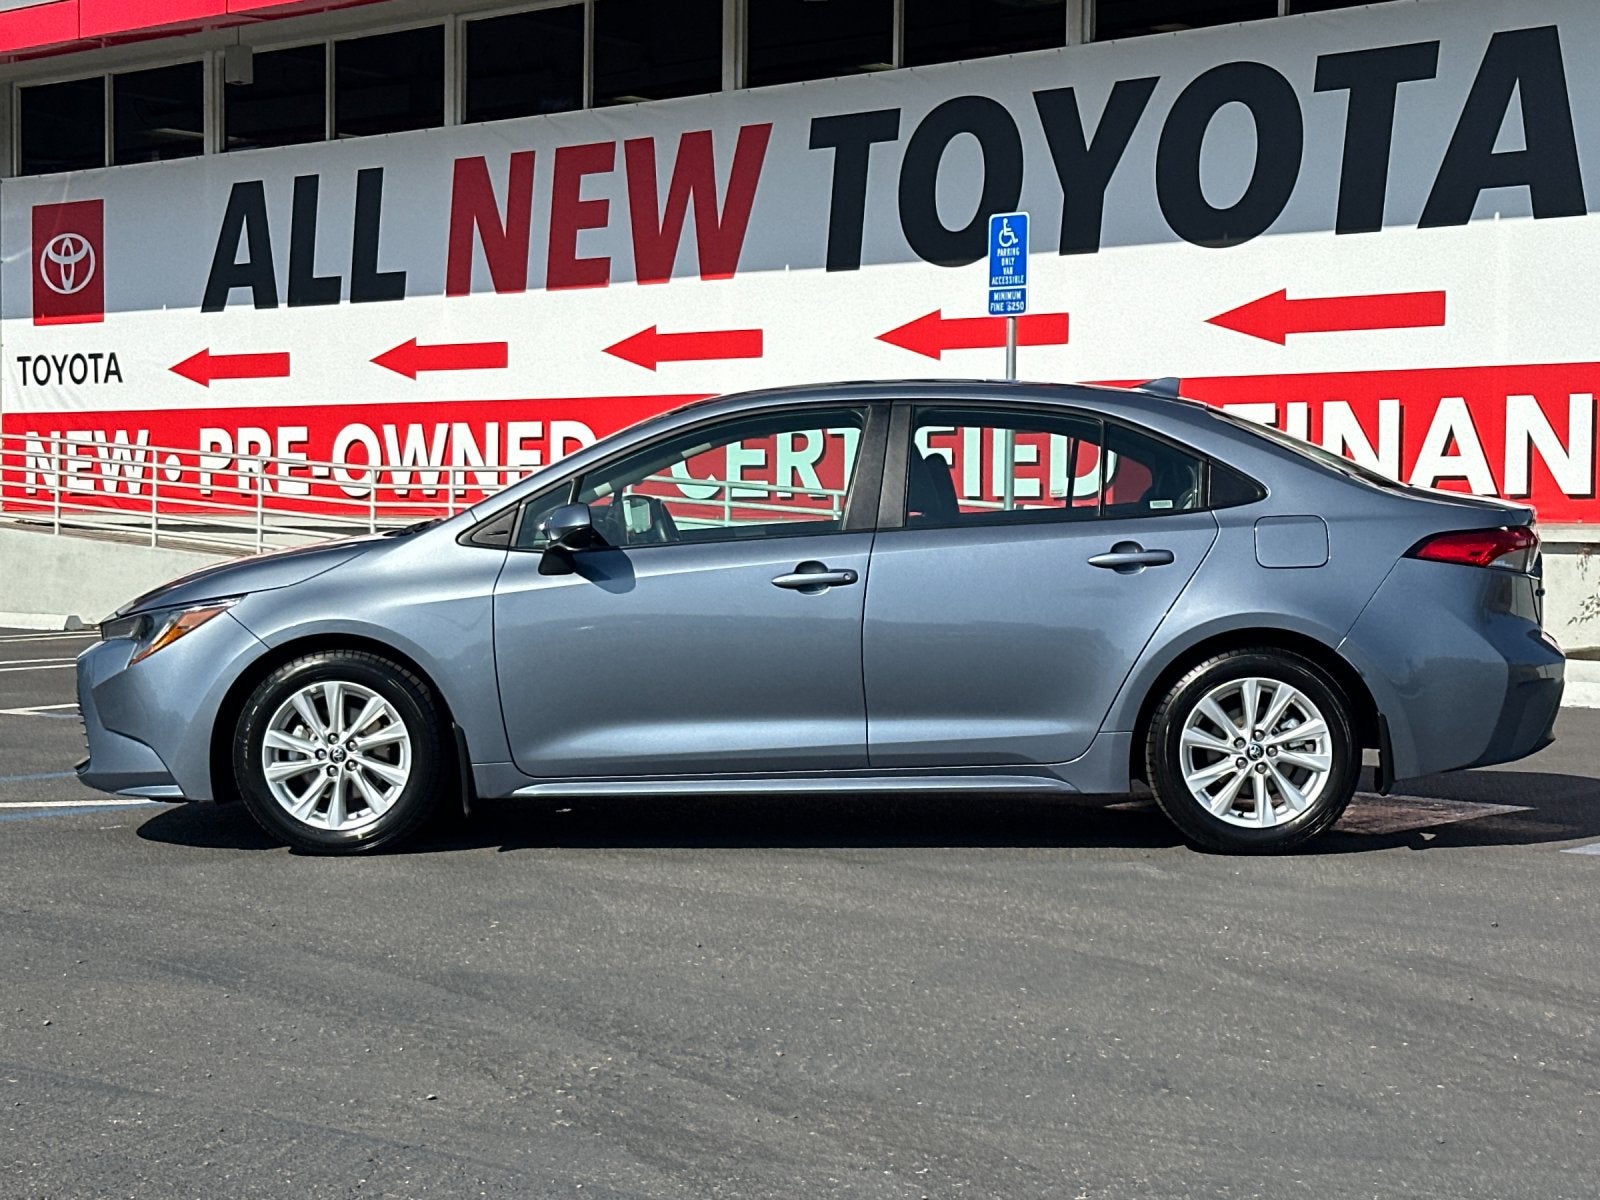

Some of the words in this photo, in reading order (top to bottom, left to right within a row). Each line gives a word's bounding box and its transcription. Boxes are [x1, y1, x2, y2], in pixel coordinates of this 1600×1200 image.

[201, 167, 406, 312] ALL
[447, 123, 773, 296] NEW
[809, 25, 1588, 271] TOYOTA
[997, 247, 1020, 257] PARKING
[1001, 257, 1015, 266] ONLY
[992, 275, 1024, 285] ACCESSIBLE
[994, 291, 1021, 301] MINIMUM
[990, 302, 1004, 312] FINE
[1006, 301, 1024, 311] $250
[17, 352, 123, 386] TOYOTA
[25, 429, 149, 495] NEW
[670, 426, 1117, 499] CERTFIED
[1222, 393, 1593, 496] NAN
